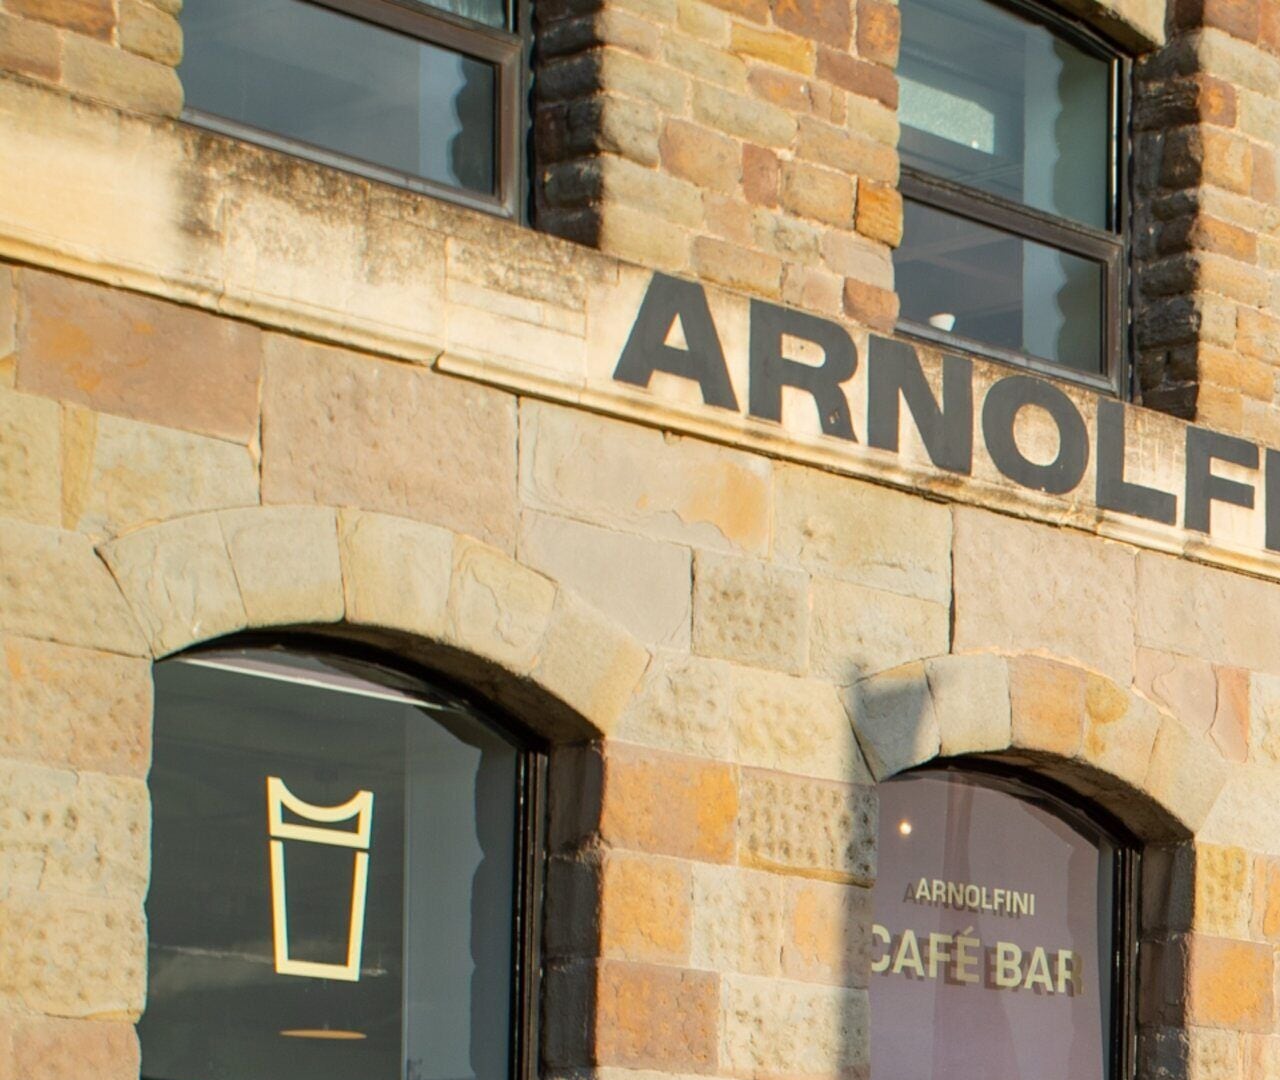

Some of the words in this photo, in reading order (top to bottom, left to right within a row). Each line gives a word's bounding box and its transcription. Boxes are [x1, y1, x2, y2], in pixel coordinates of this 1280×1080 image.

[915, 877, 1035, 916] ARNOLFINI
[871, 924, 980, 983] CAFÉ
[996, 941, 1084, 995] BAR
